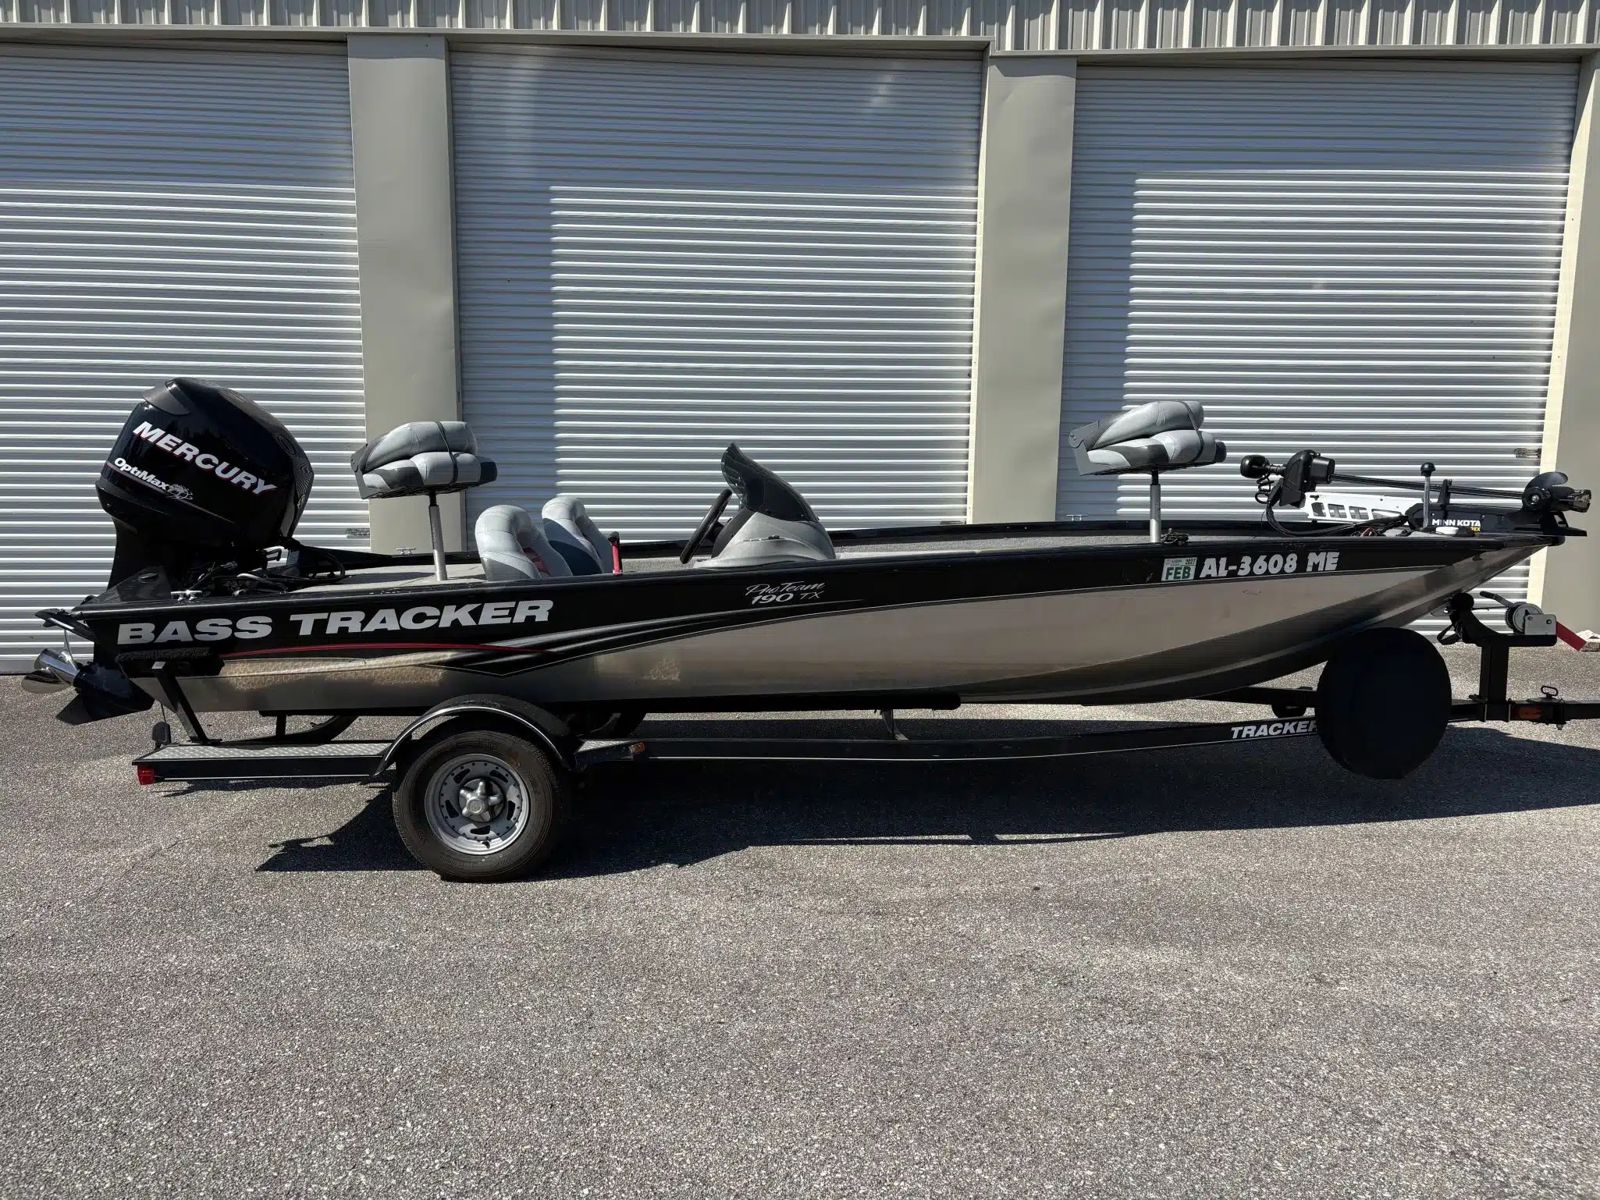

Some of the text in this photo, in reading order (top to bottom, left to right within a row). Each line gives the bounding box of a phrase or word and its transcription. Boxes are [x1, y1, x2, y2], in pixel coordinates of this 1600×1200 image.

[133, 421, 278, 495] MERCURY
[114, 457, 170, 491] OptiMax
[1457, 519, 1481, 527] KOTA
[1165, 566, 1192, 580] FEB
[1200, 552, 1340, 578] AL-3608 ME
[751, 590, 825, 605] 190 TX
[117, 599, 554, 646] BASS TRACKER
